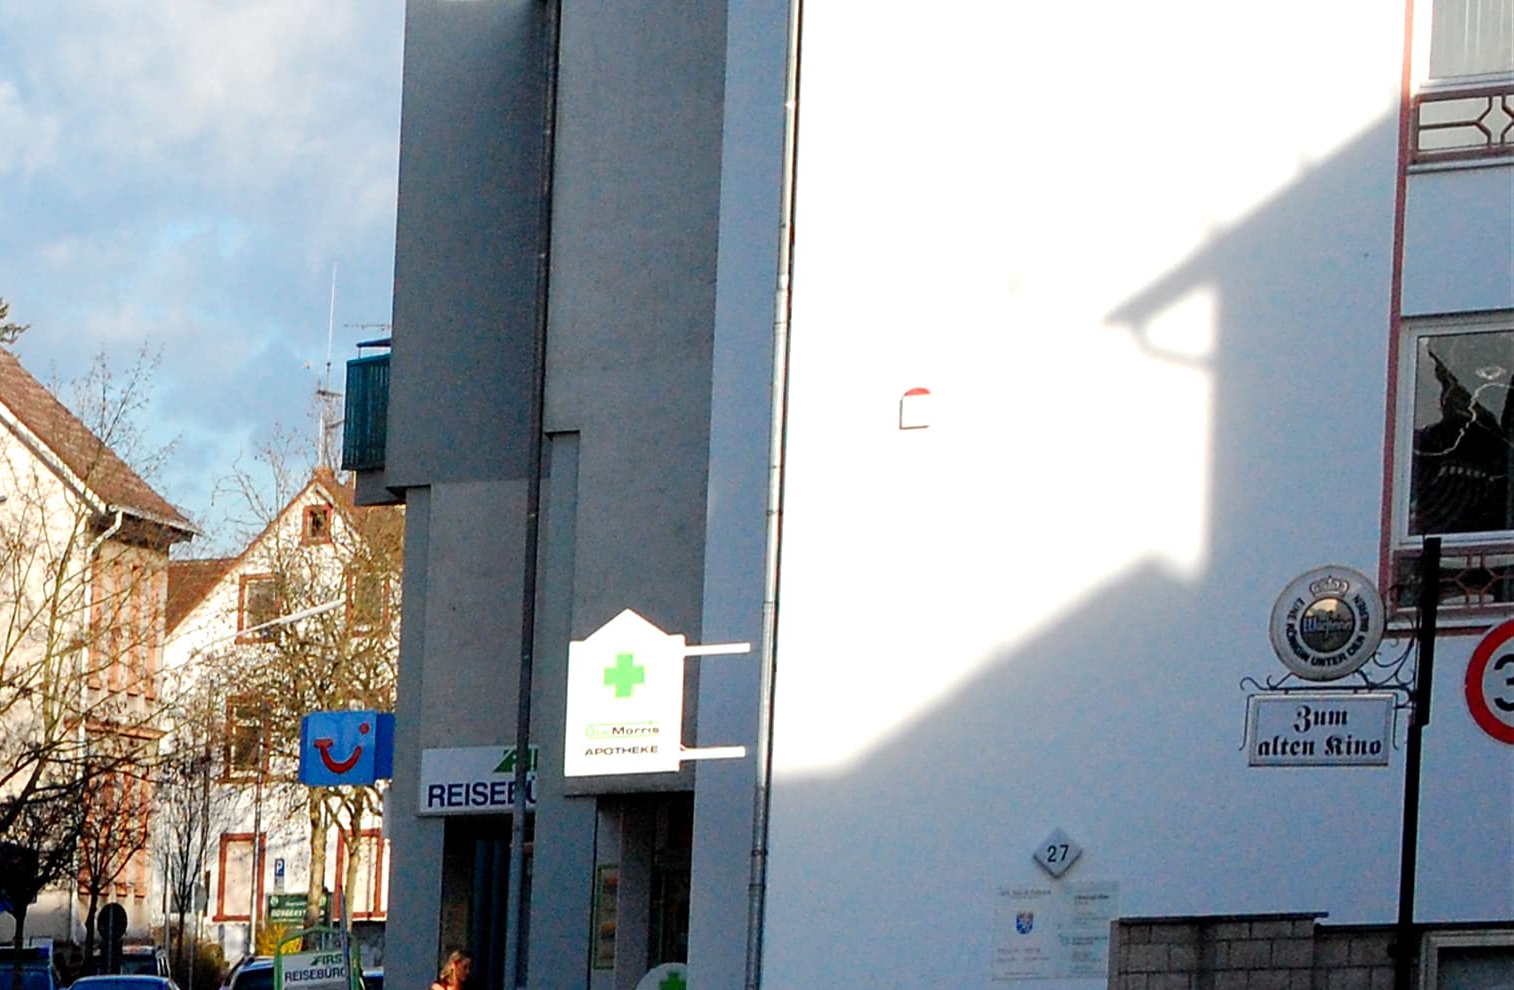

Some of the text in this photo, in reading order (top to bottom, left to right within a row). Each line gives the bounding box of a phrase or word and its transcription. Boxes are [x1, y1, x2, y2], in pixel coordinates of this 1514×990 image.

[1310, 653, 1348, 667] UNTER
[1293, 705, 1348, 733] Zum
[584, 745, 658, 756] APOTHEKE
[1258, 735, 1382, 756] alten Kino
[1047, 844, 1069, 863] 27
